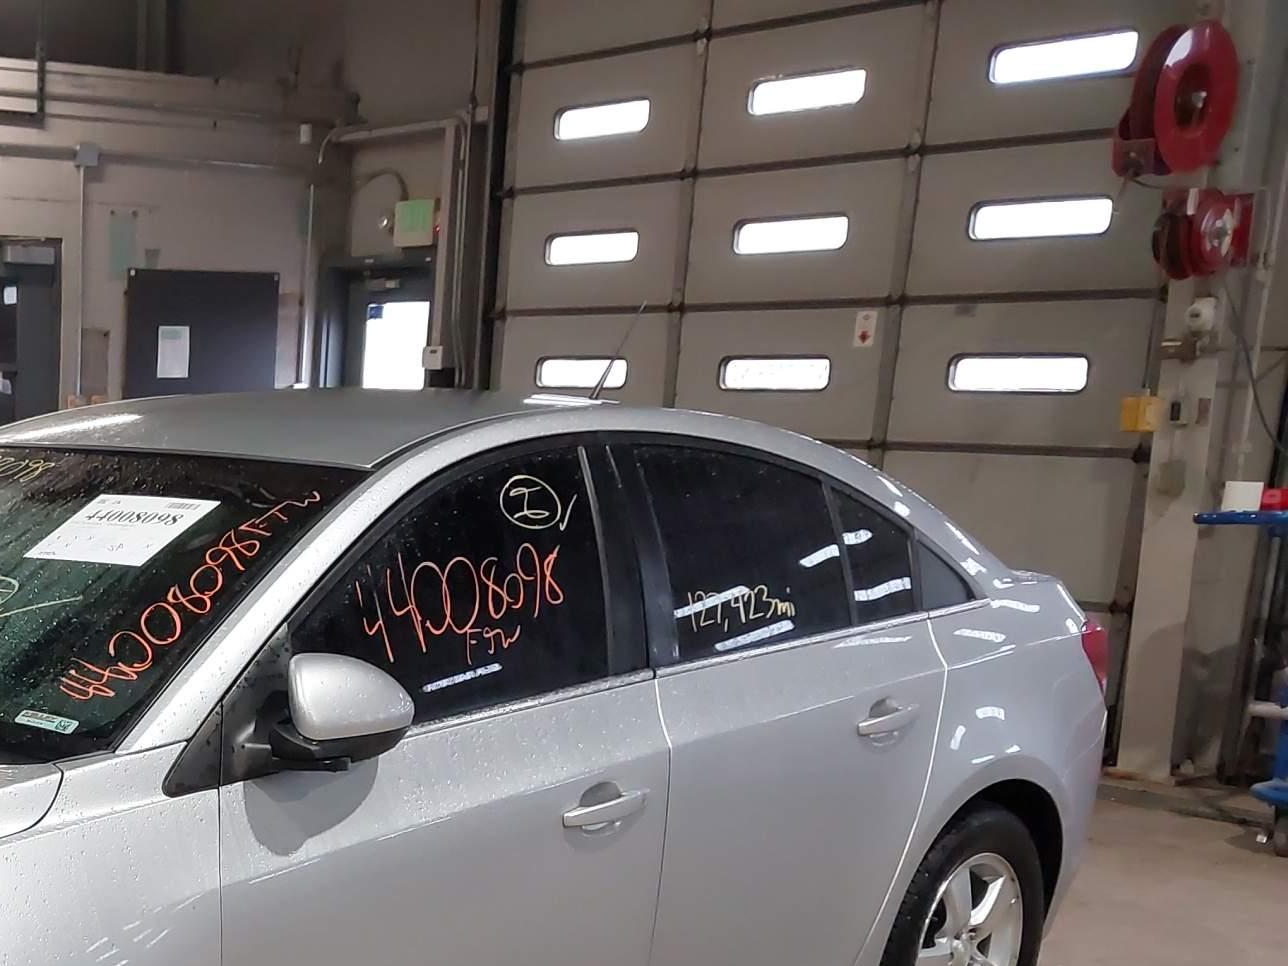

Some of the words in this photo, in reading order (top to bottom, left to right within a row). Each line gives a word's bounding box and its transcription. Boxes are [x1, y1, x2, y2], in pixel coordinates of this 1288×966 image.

[85, 509, 184, 526] 44008098
[60, 529, 260, 699] 44008098
[355, 543, 564, 663] 44008098
